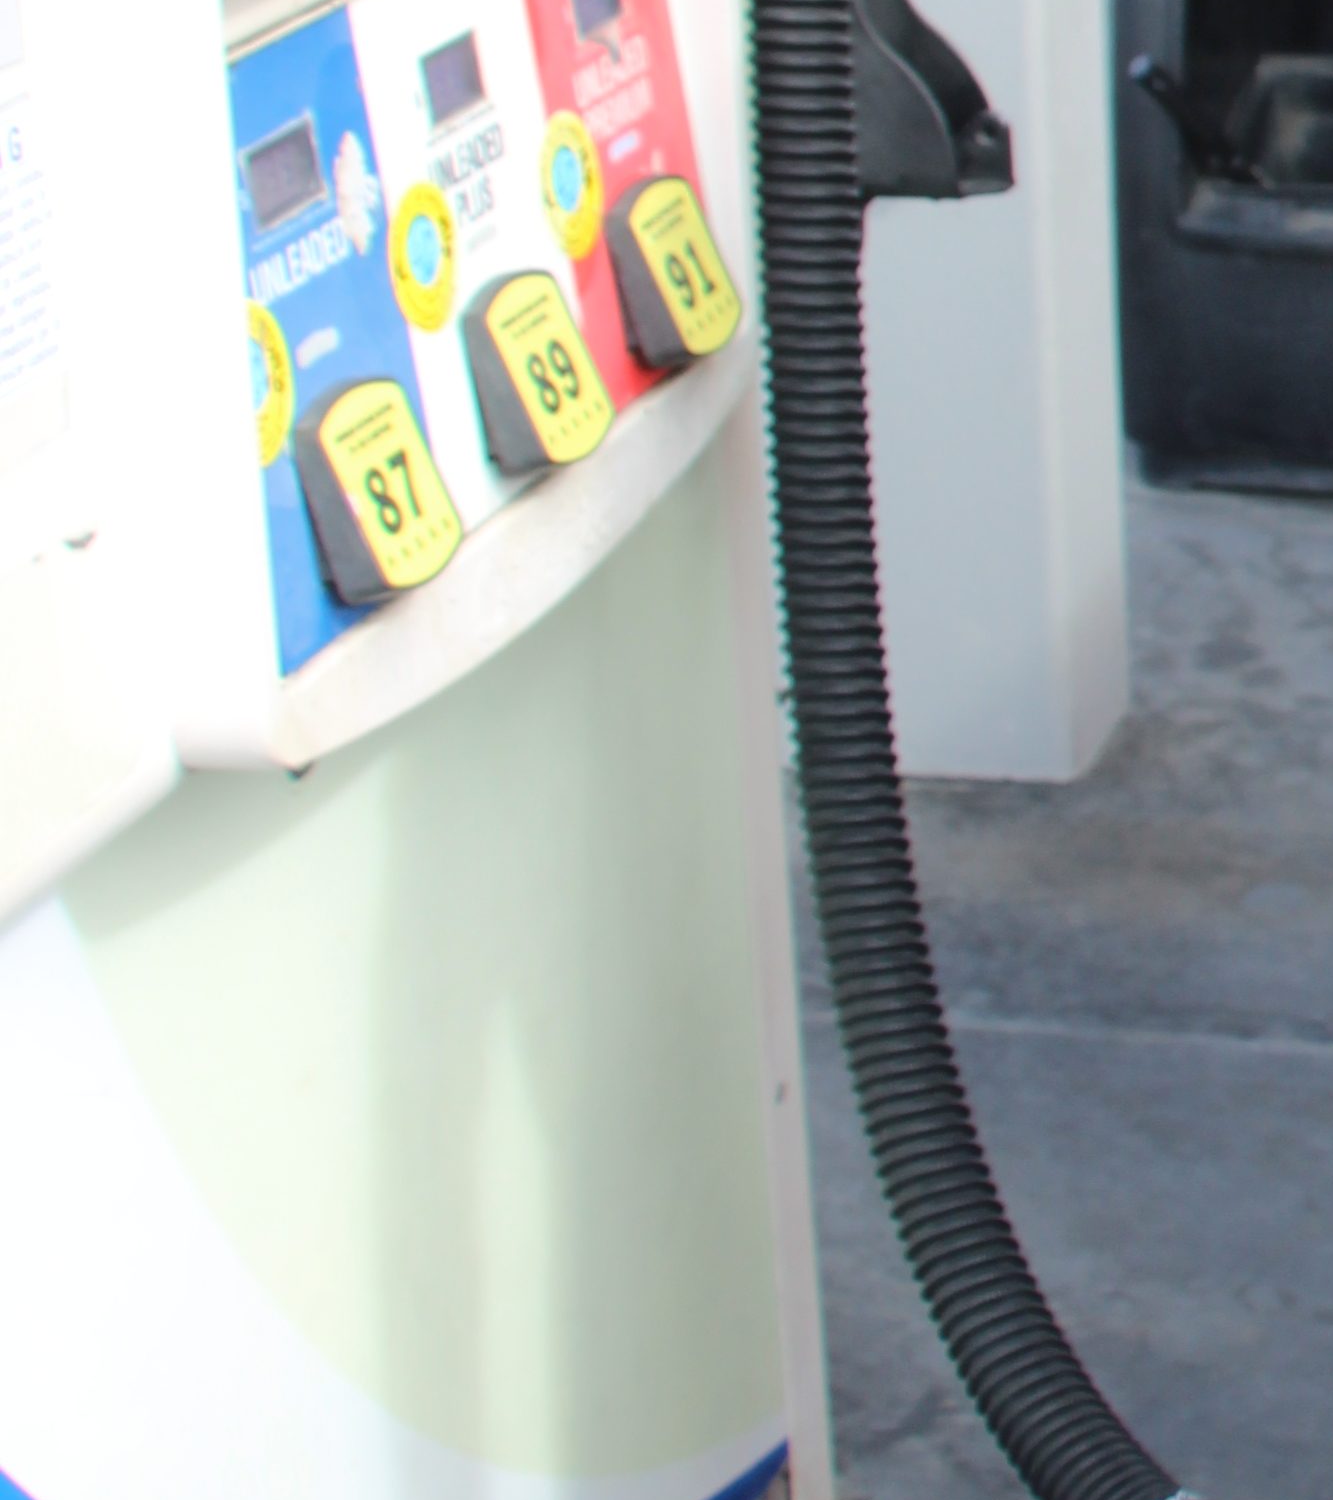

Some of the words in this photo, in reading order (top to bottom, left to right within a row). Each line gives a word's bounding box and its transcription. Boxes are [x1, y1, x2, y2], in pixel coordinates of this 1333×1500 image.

[428, 121, 504, 191] UNLEADED
[455, 173, 495, 227] PLUS
[248, 214, 351, 306] UNLEADED
[663, 239, 716, 310] 91
[526, 338, 581, 416] 89
[364, 449, 423, 535] 87
